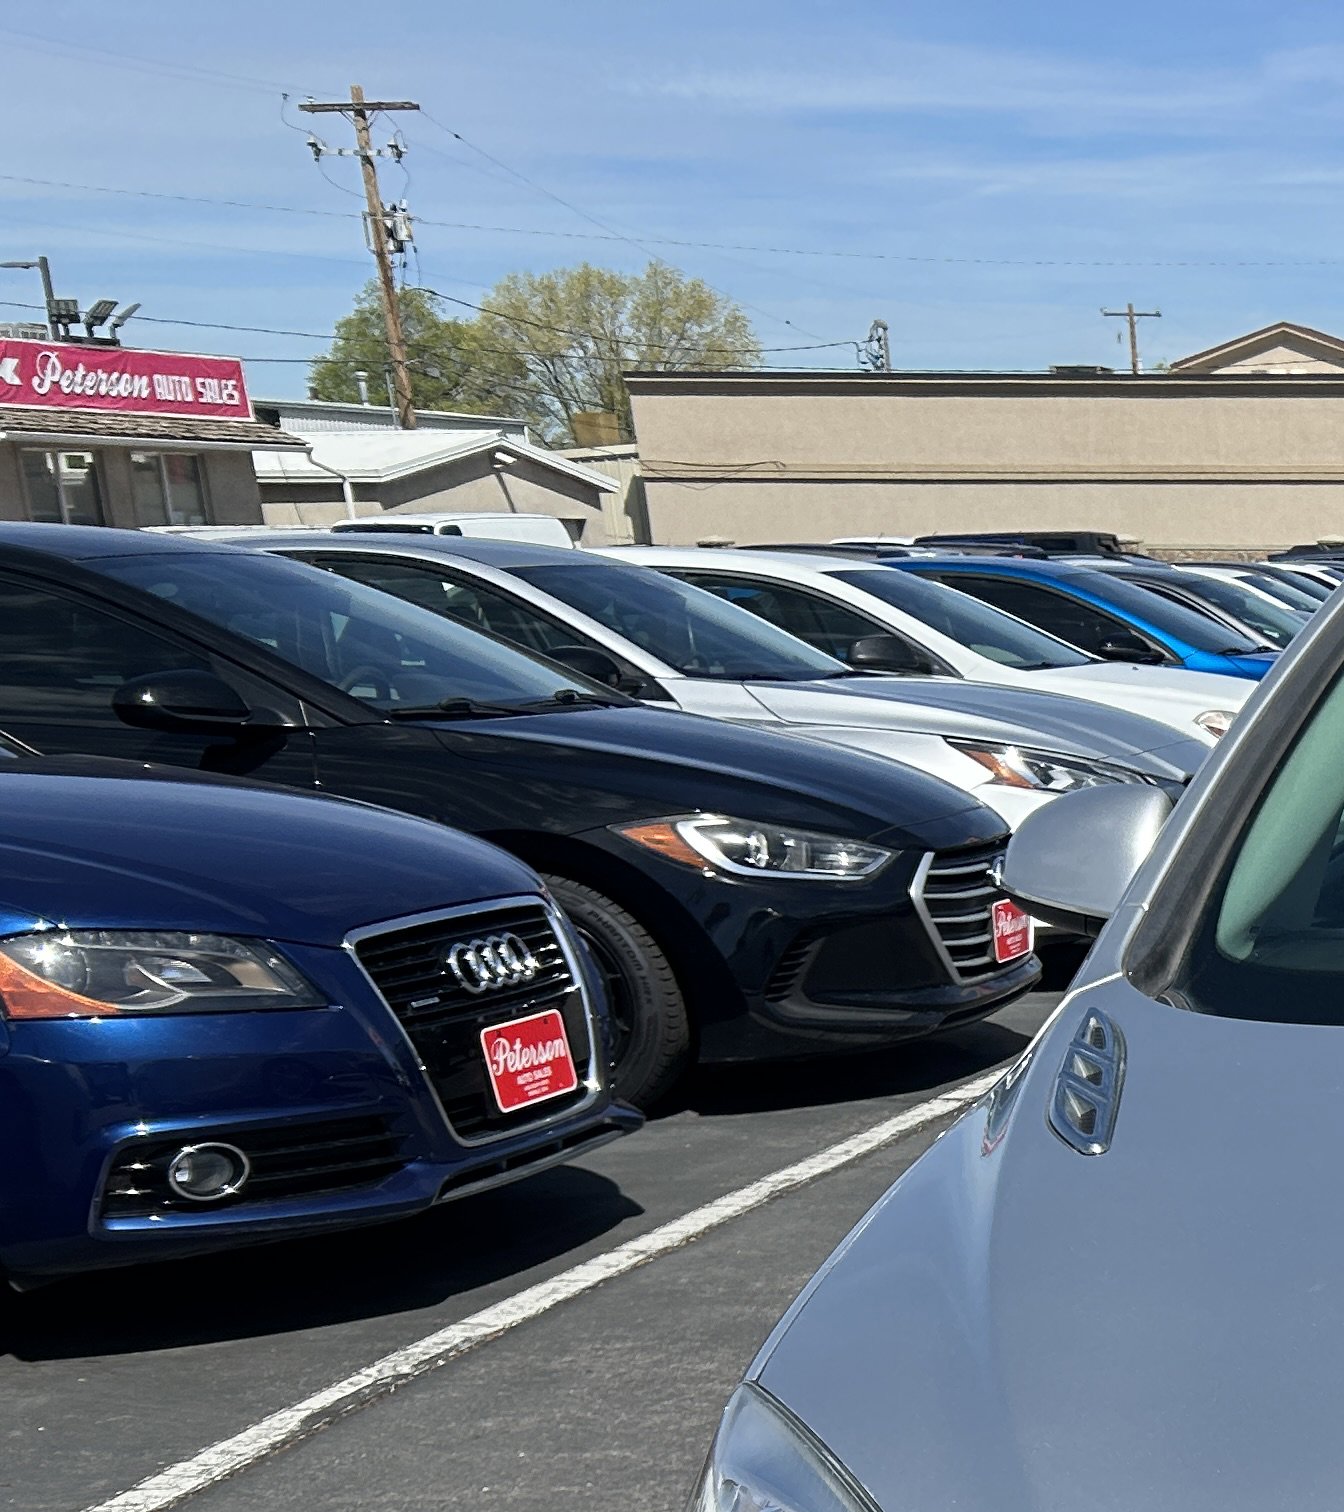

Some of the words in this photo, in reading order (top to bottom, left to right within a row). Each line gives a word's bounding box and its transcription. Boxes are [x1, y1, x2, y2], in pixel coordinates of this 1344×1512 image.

[32, 351, 151, 400] Peterson
[152, 373, 194, 402] AUTO
[195, 376, 241, 406] SALES
[491, 1036, 567, 1077] Peterson
